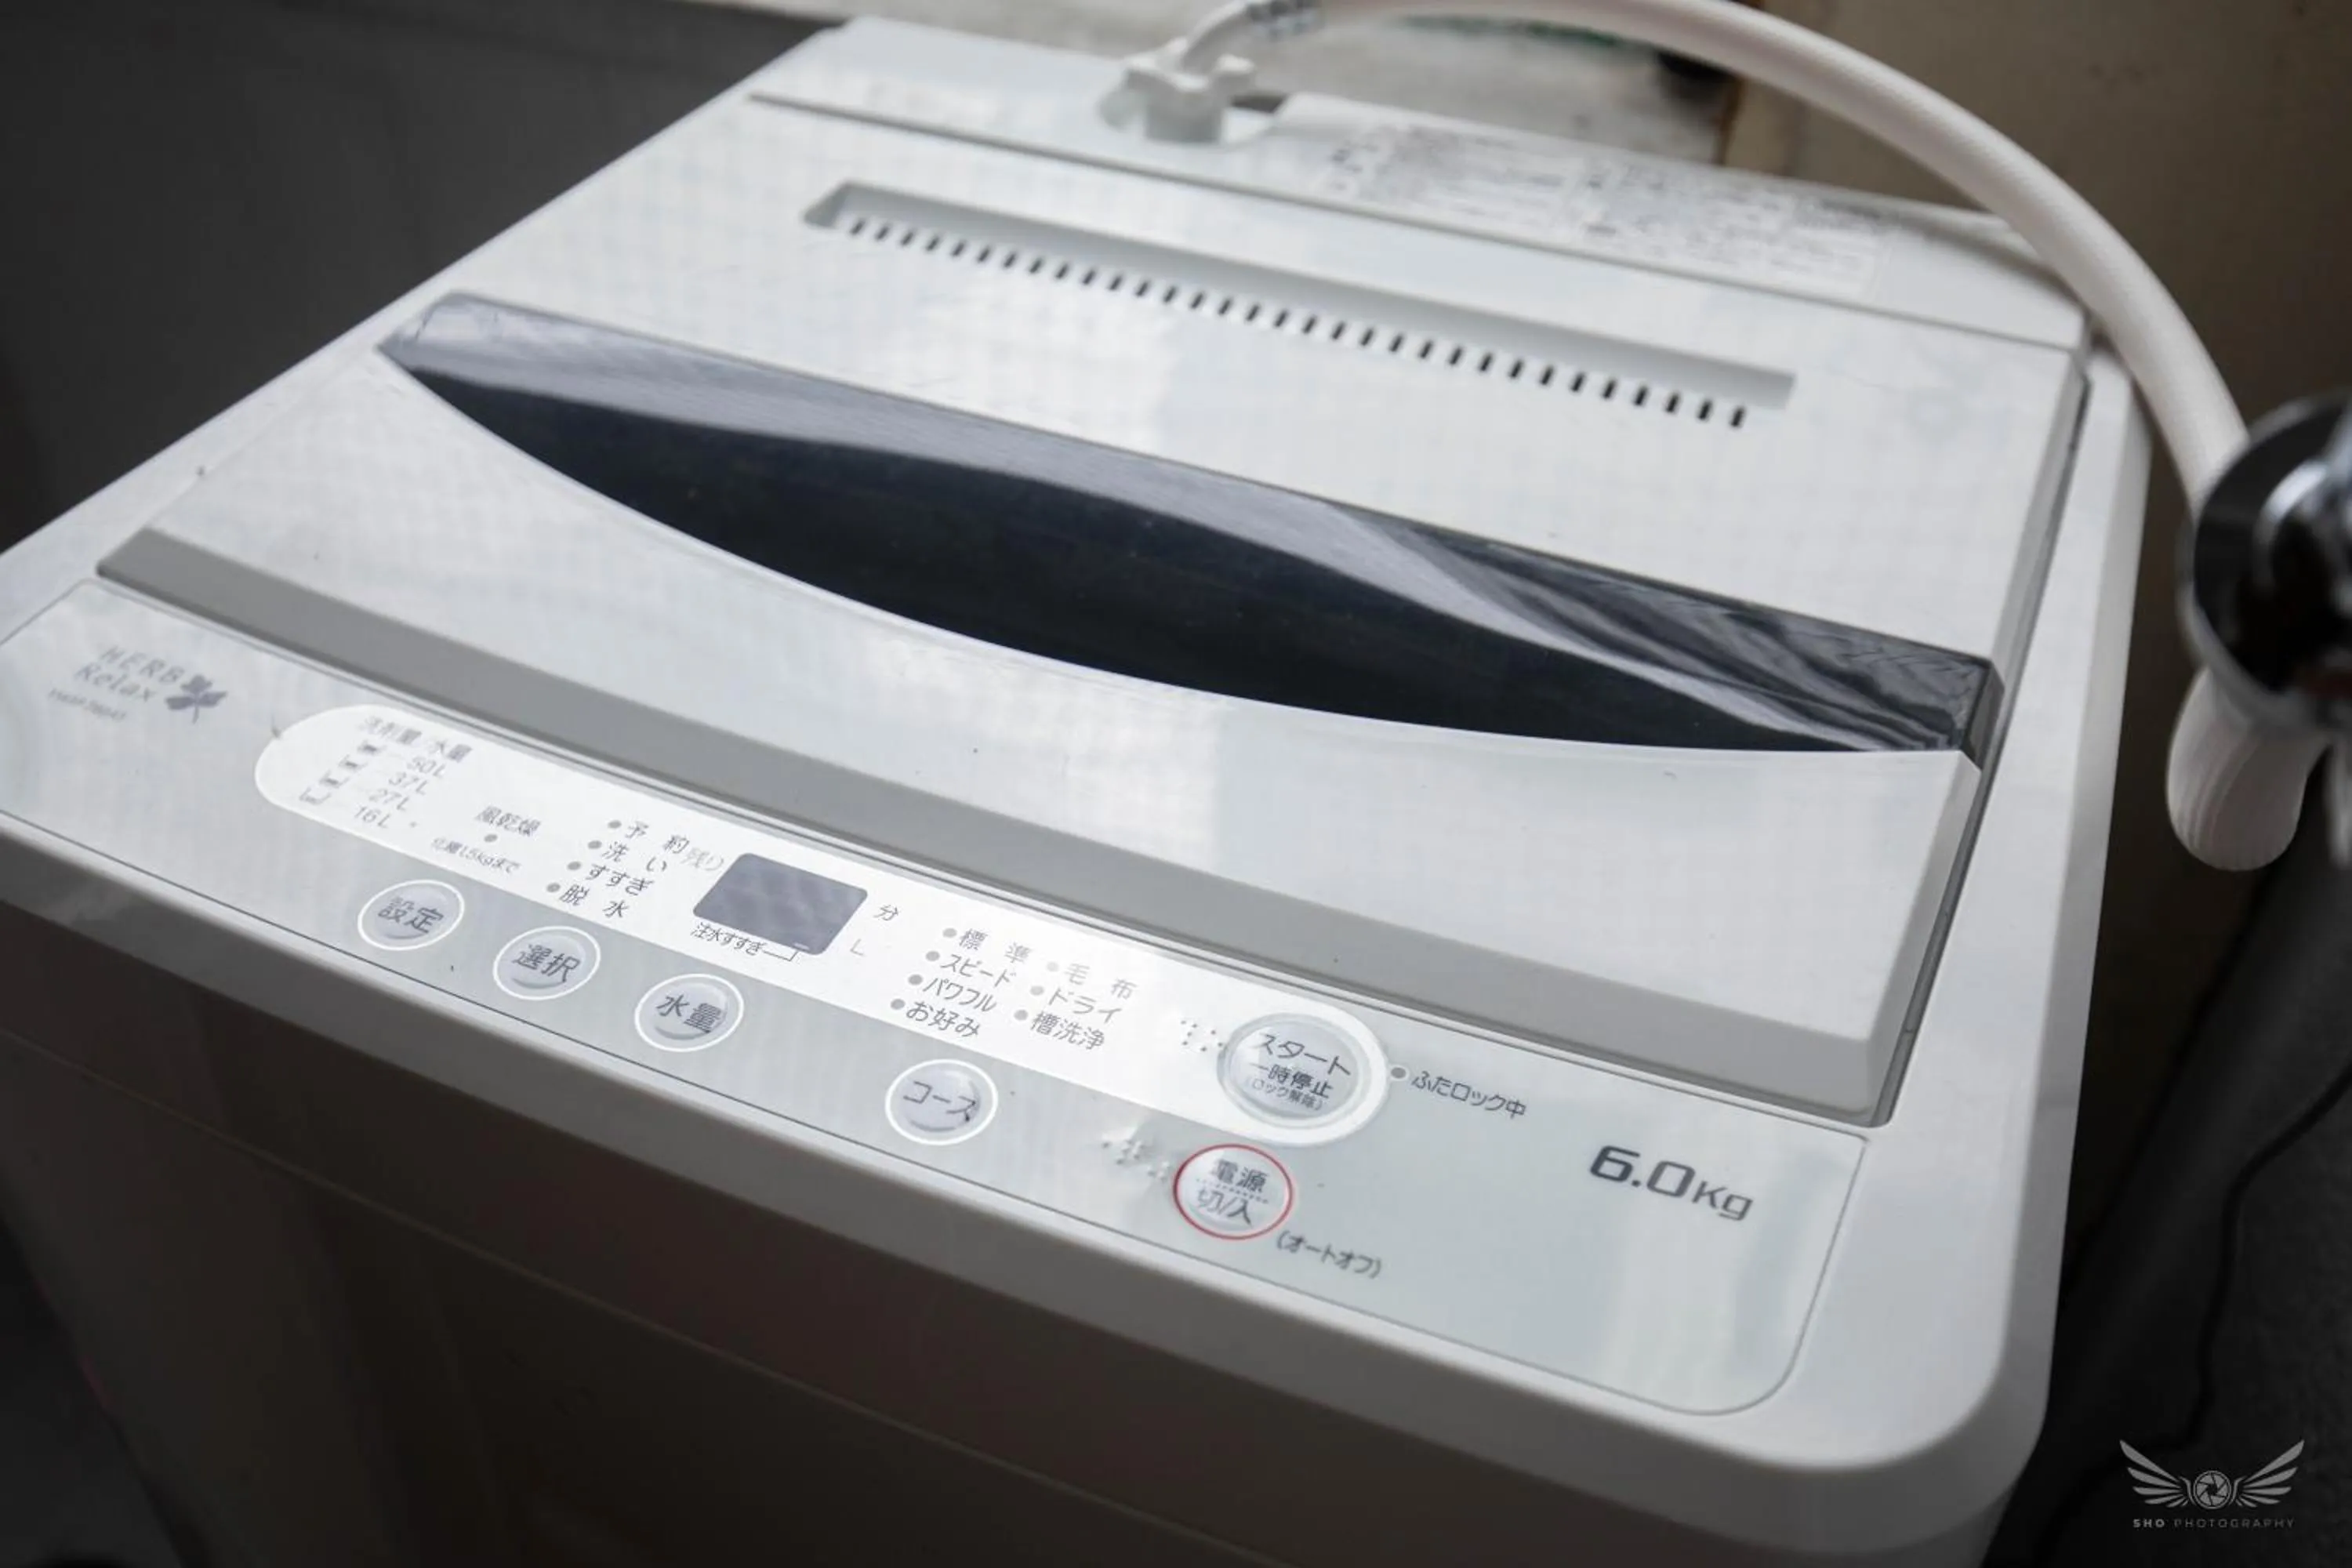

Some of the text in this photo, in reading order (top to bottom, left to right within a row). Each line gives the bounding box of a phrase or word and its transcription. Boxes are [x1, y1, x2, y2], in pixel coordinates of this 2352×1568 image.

[98, 644, 185, 684] HERB
[368, 789, 409, 811] 27L
[388, 771, 428, 795] 37L
[354, 806, 391, 828] 16L
[586, 864, 655, 895] すすぎ
[378, 896, 445, 934] 設定
[873, 905, 901, 921] 分
[690, 922, 768, 956] 注水すすぎ
[512, 943, 581, 984] 選択
[940, 953, 1016, 988] スピード
[923, 978, 997, 1012] パワフル
[1048, 988, 1123, 1023] ドライ
[656, 993, 727, 1034] 水量
[906, 1000, 982, 1037] お好み
[1031, 1010, 1105, 1050] 槽洗浄
[1249, 1033, 1351, 1075] スタート
[1250, 1063, 1334, 1098] 一時停止
[1411, 1070, 1527, 1120] ふたロック中
[902, 1080, 978, 1121] コース
[1212, 1158, 1268, 1192] 電源
